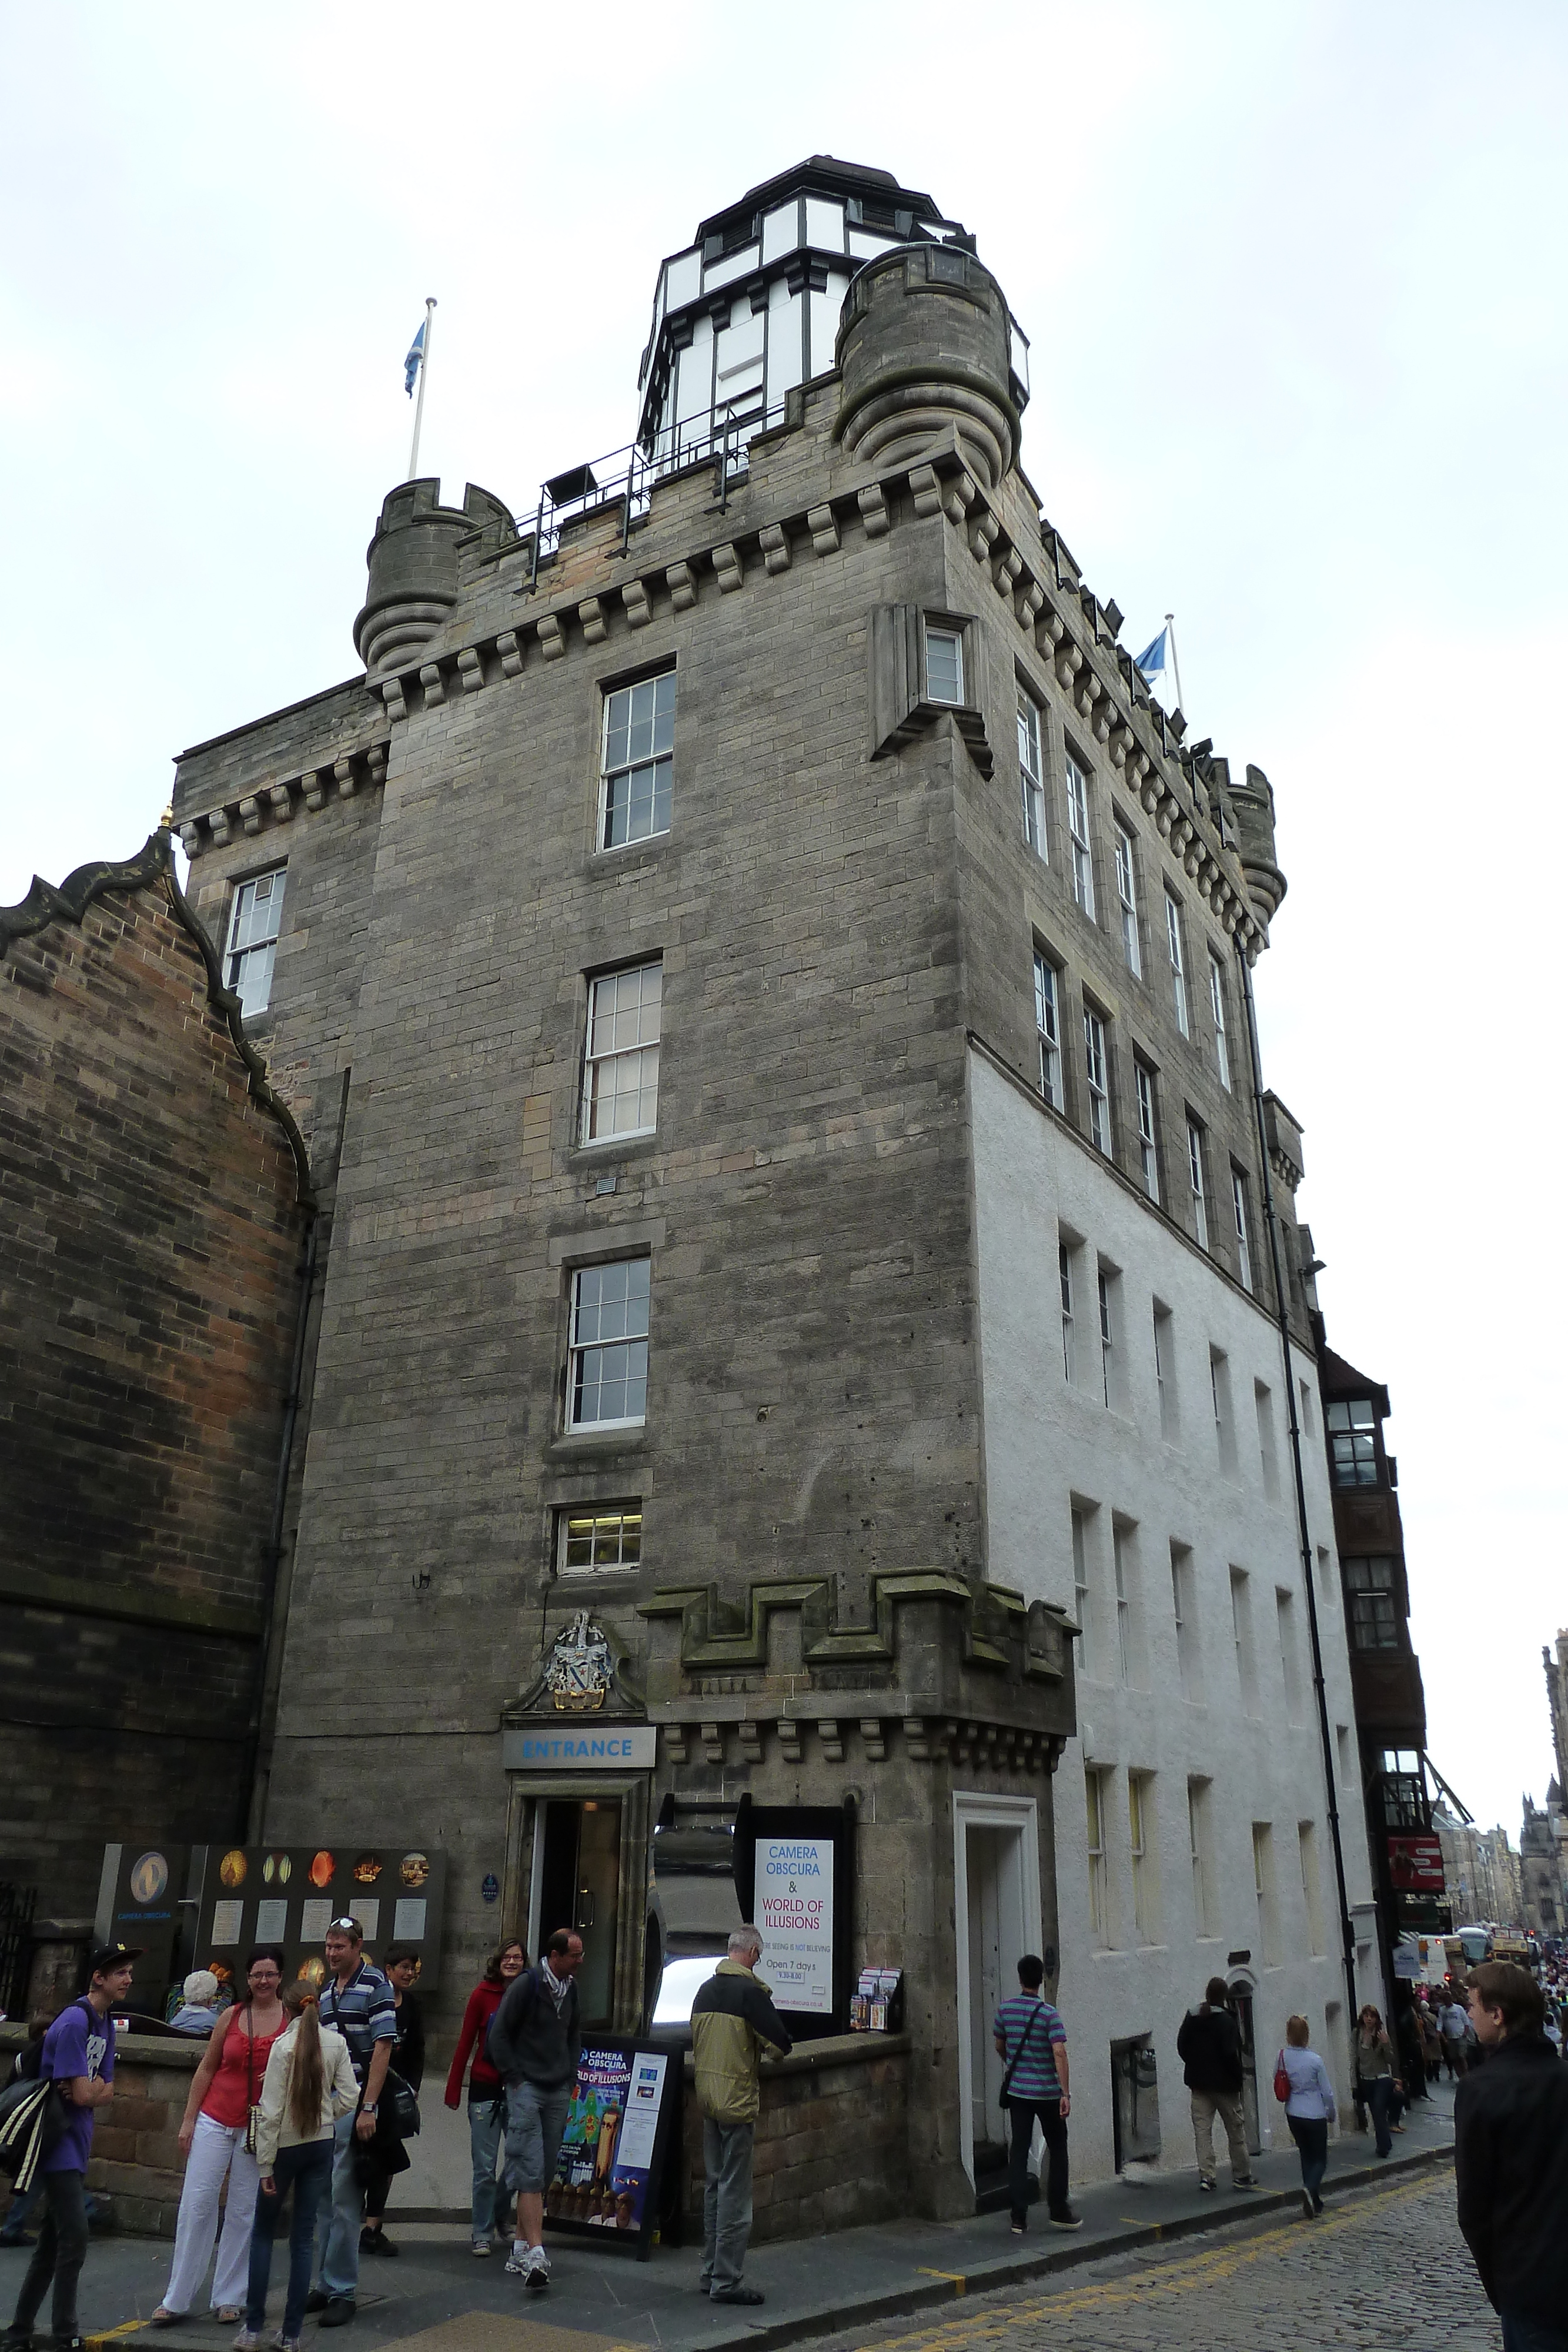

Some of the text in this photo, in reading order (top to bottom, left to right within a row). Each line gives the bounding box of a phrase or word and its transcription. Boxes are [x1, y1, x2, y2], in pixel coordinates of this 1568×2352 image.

[523, 1739, 632, 1758] ENTRANCE
[769, 1846, 818, 1859] CAMERA
[766, 1862, 820, 1875] OBSCURA
[789, 1881, 797, 1893] &
[762, 1898, 824, 1913] WORLD OF
[765, 1915, 820, 1929] ILLUSIONS
[807, 1945, 831, 1953] BELIEVING
[767, 1959, 787, 1969] Open
[797, 1962, 816, 1972] days
[590, 2051, 623, 2062] CAMERA
[588, 2059, 627, 2070] OBSCURA
[577, 2070, 631, 2084] RLD OF ILLUSIONS
